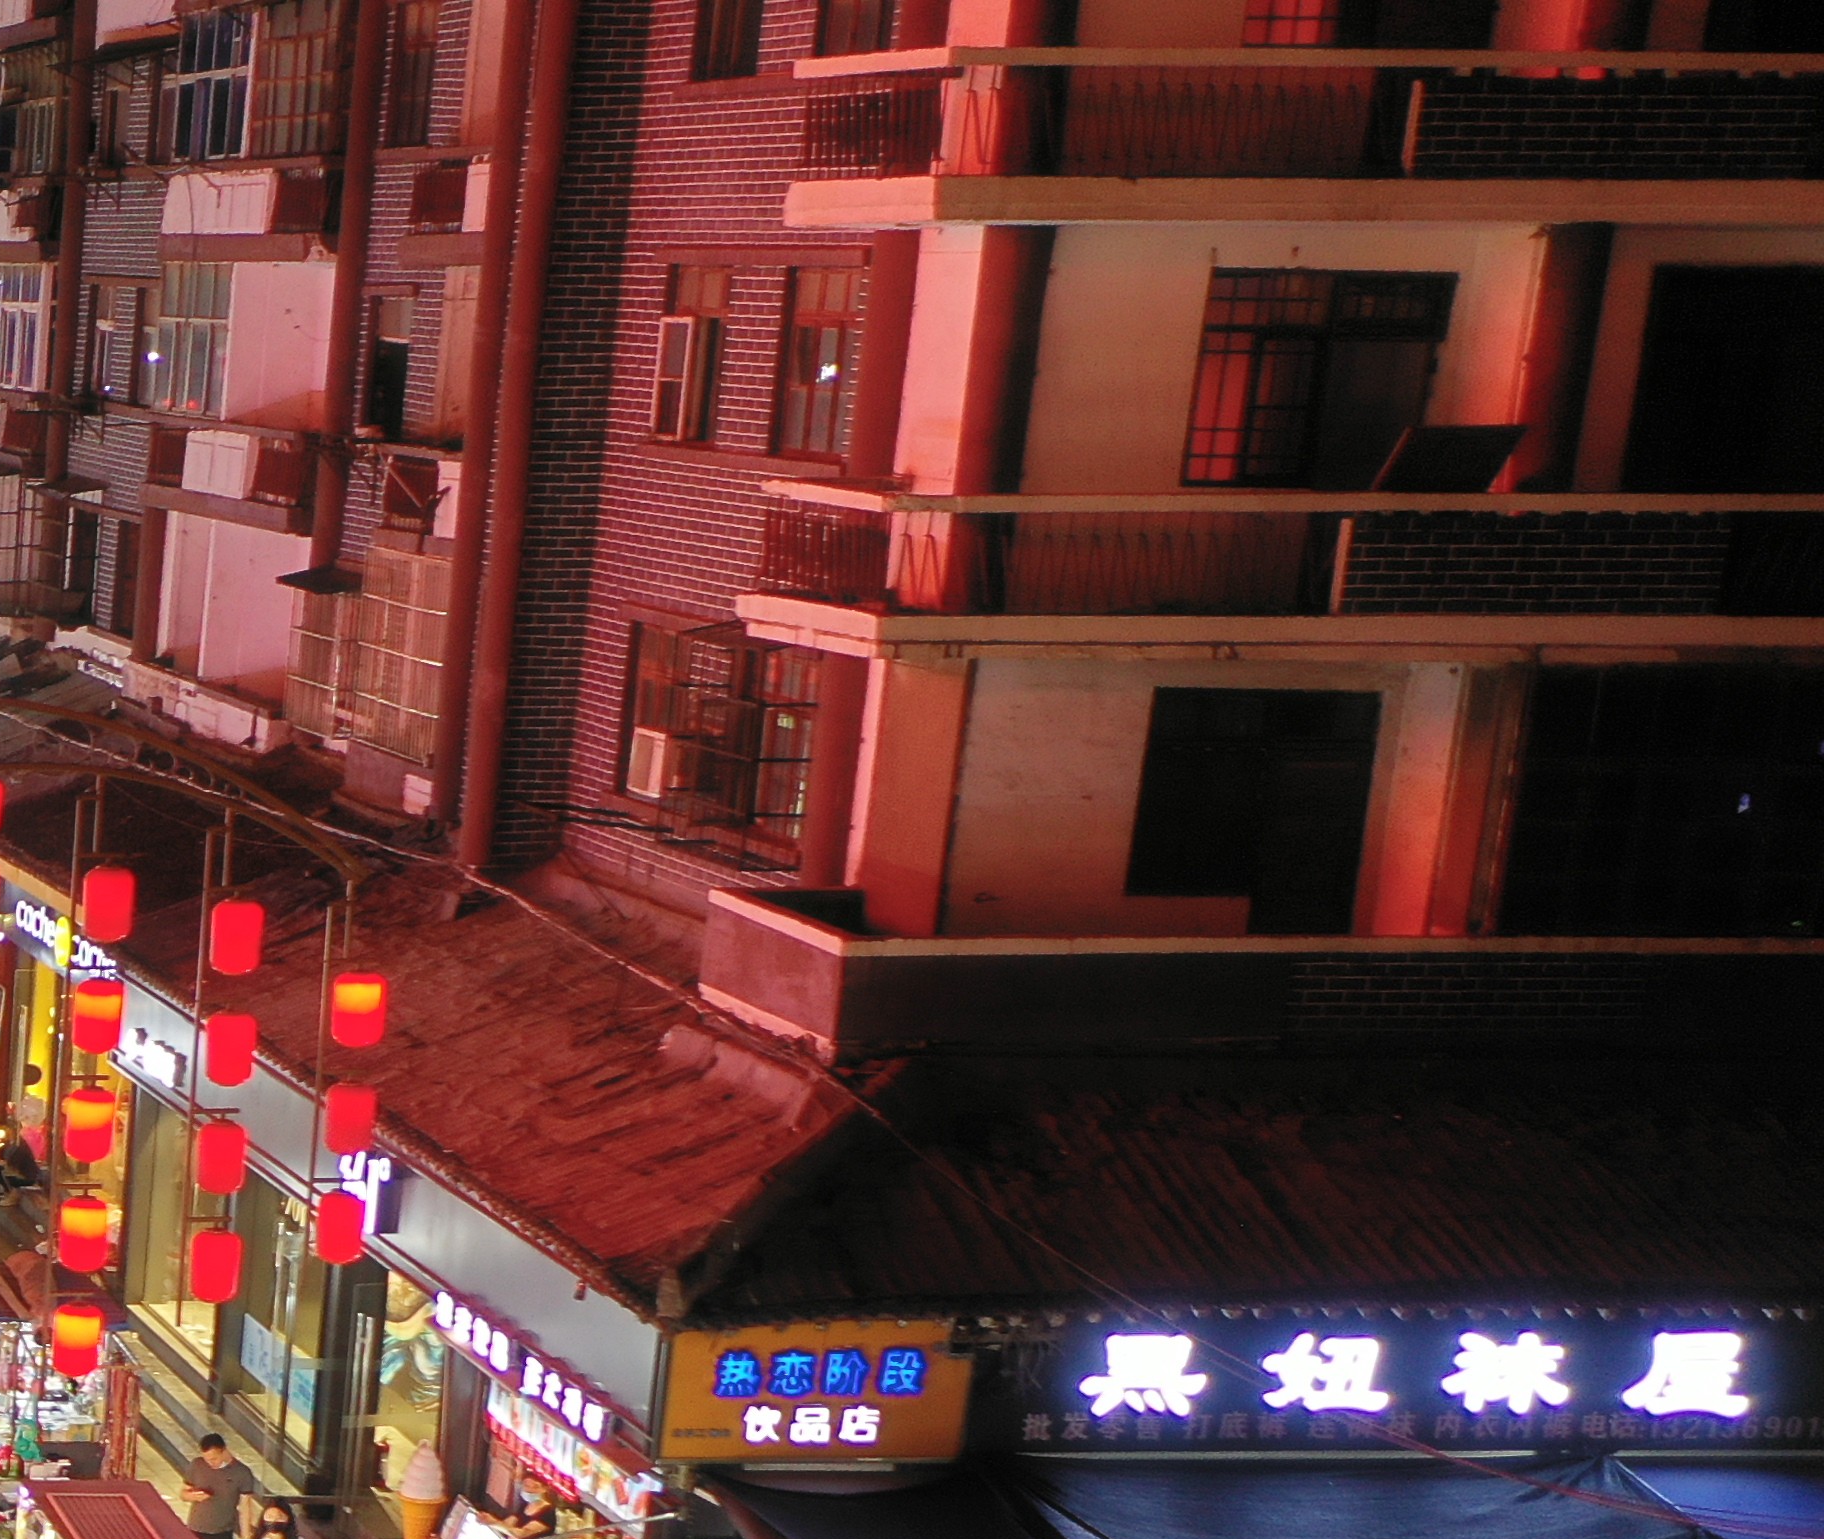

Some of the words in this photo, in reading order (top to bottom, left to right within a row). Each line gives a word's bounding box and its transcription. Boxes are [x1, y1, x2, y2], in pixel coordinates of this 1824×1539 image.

[714, 1348, 925, 1397] 热恋阶段
[1079, 1331, 1750, 1418] 黑妞袜屋
[743, 1404, 881, 1444] 饮品店
